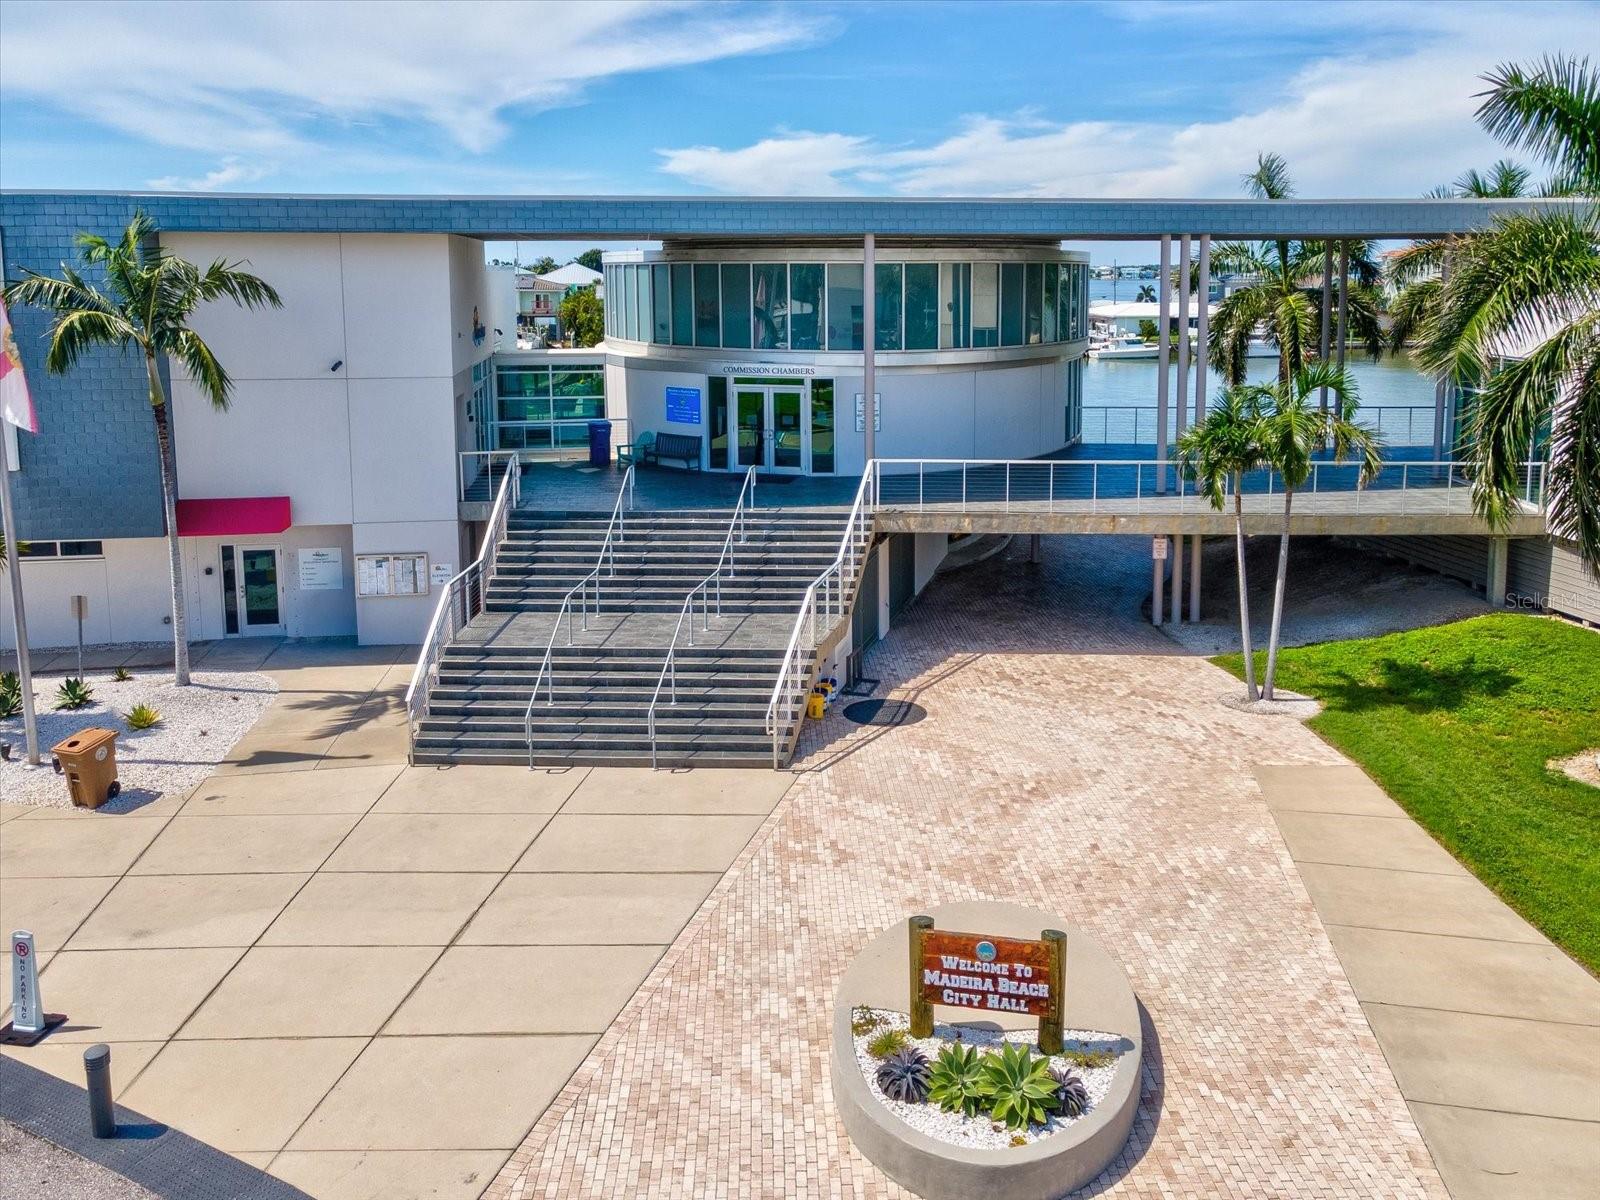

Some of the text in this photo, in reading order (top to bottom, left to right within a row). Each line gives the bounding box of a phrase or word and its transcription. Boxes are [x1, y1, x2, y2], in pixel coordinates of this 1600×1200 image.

[723, 366, 815, 375] COMMISSION CHAMBERS
[20, 958, 25, 972] NO
[940, 955, 1009, 975] WELCOME
[924, 969, 1049, 997] MADEIRA BEACH
[942, 989, 1029, 1012] CITY HALL
